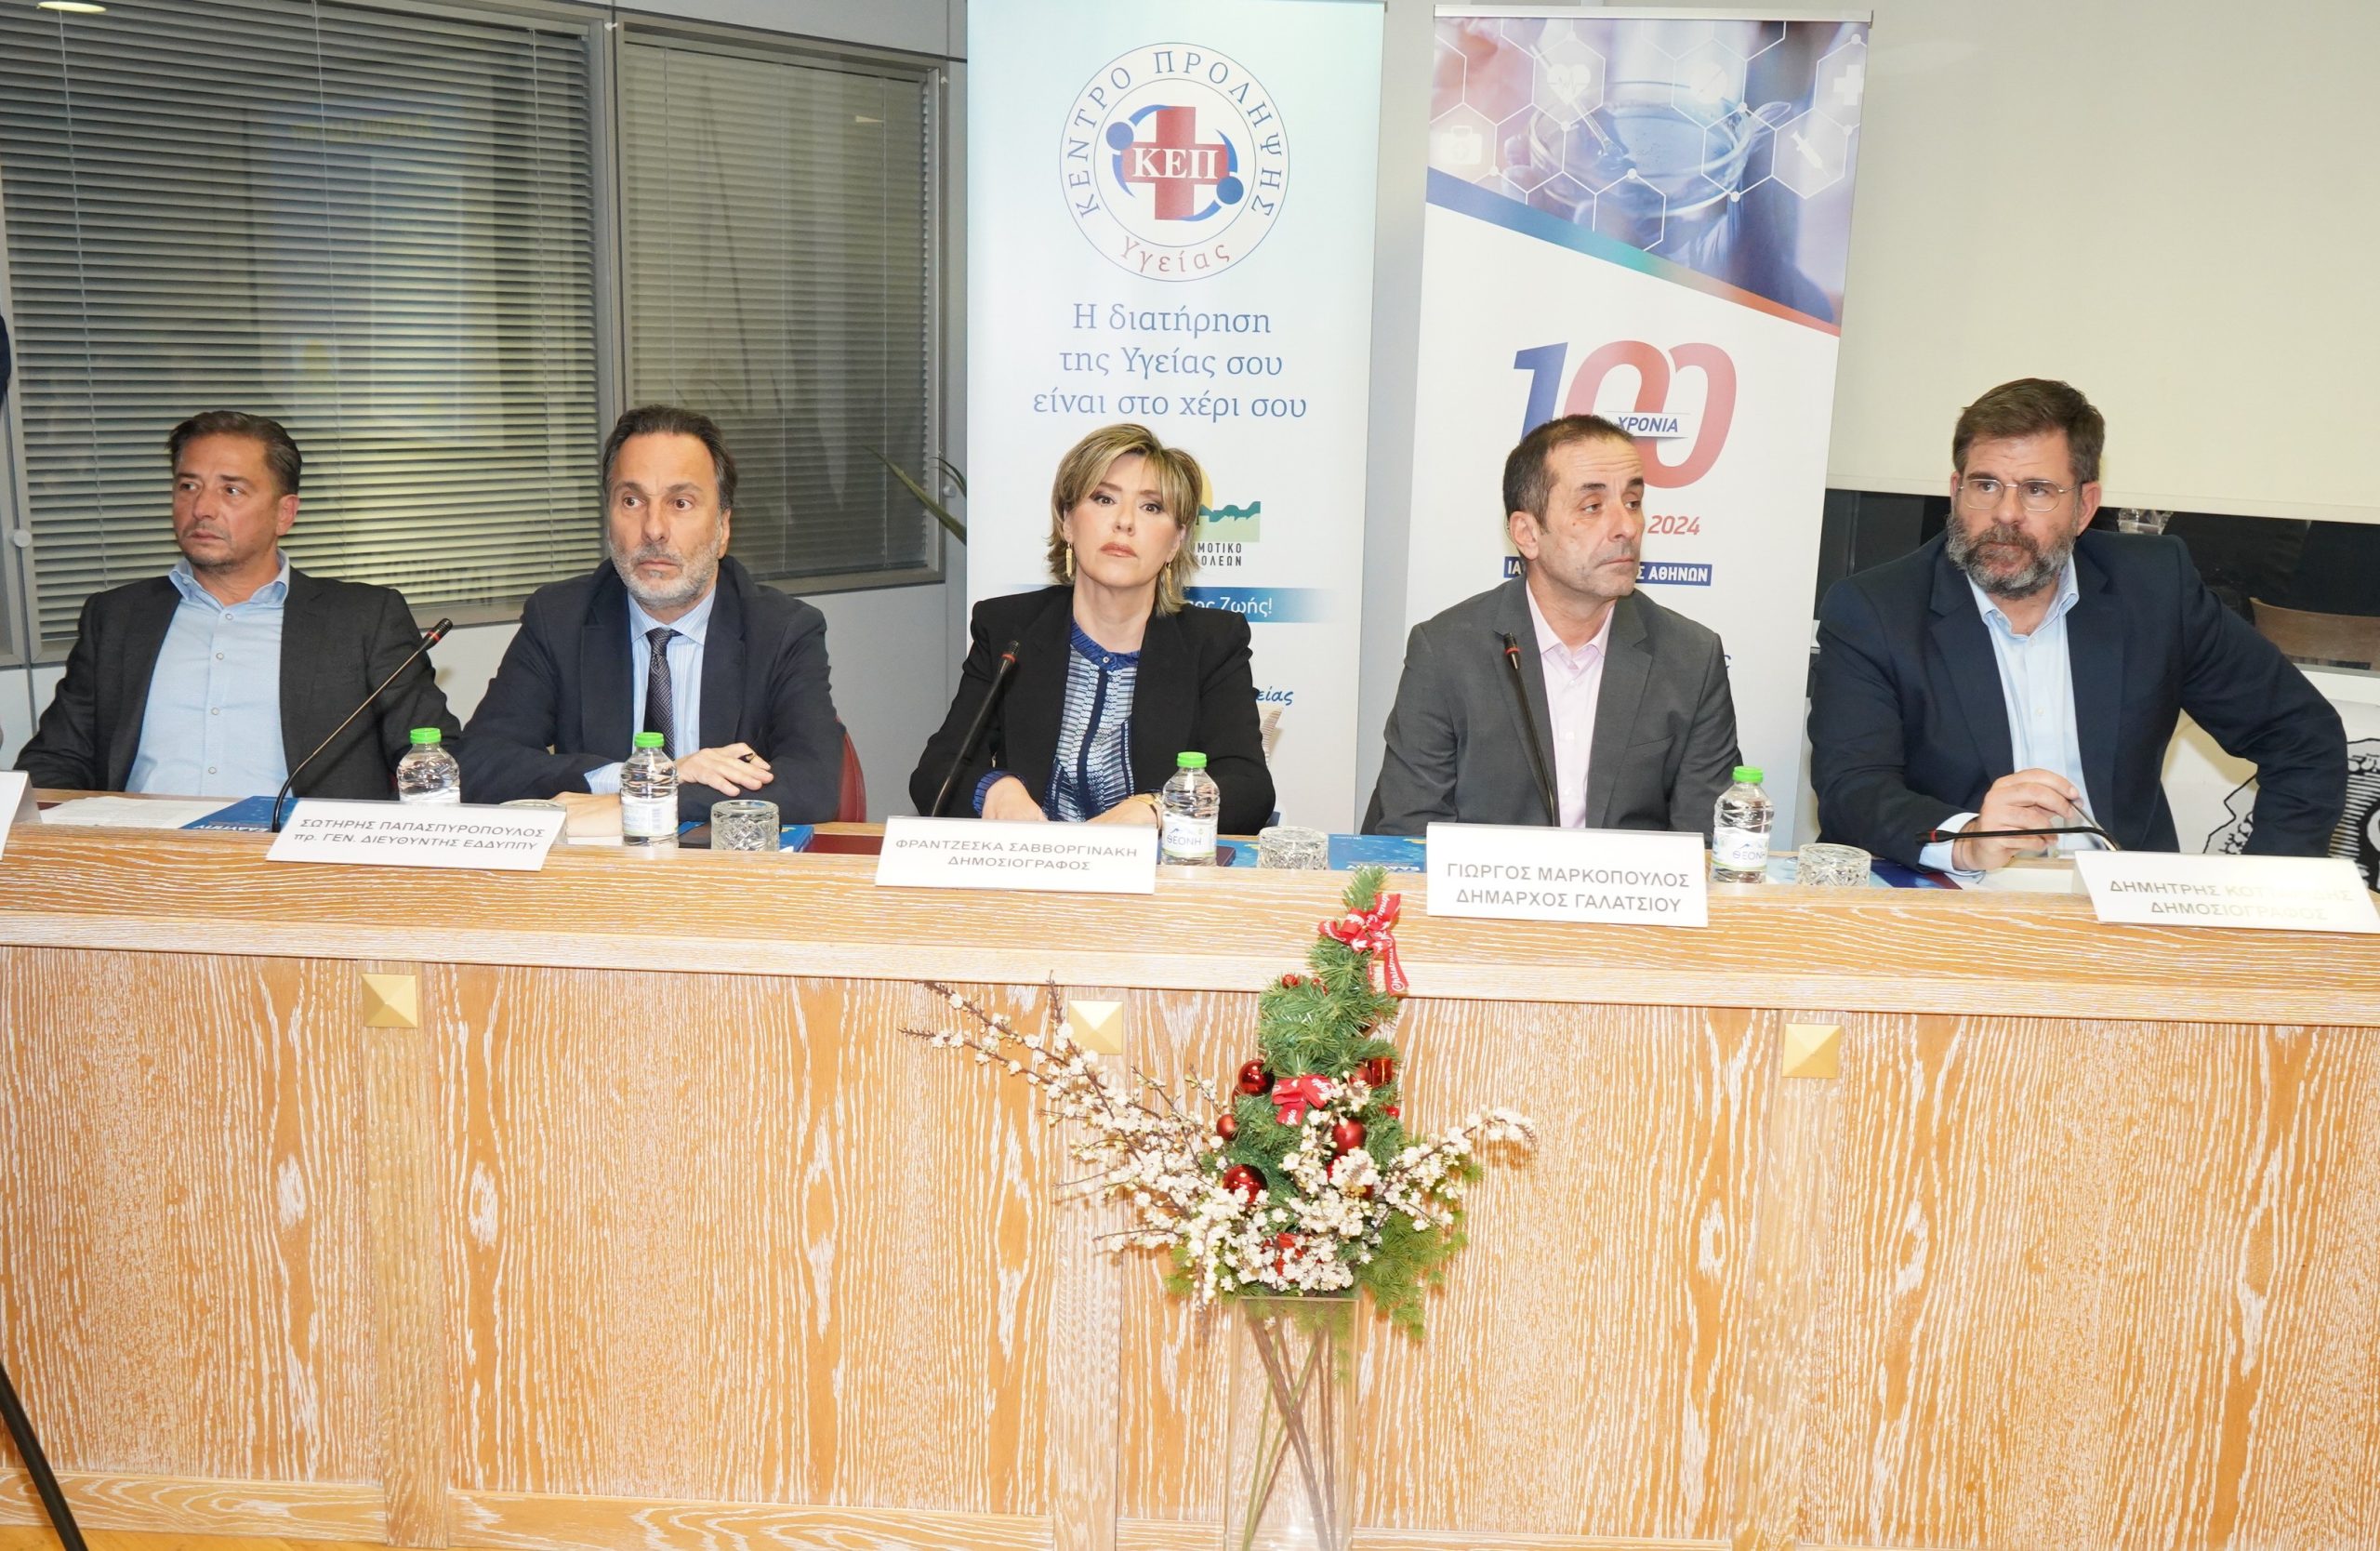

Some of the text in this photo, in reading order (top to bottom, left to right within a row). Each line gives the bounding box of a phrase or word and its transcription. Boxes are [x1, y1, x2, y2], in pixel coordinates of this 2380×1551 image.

[1067, 50, 1283, 218] ΚΕΝΤΡΟ ΠΡΟΛΗΨΗΣ
[1131, 146, 1219, 180] ΚΕΠ
[1121, 235, 1230, 273] Υγείας
[1073, 303, 1271, 338] Η διατήρηση
[1060, 347, 1283, 379] της Υγείας σου
[1033, 388, 1307, 423] είναι στο χέρι σου
[1618, 417, 1678, 432] ΧΡΟΝΙΑ
[1646, 514, 1700, 536] 2024
[1194, 542, 1242, 553] ΜΟΤΙΚΟ
[1197, 555, 1242, 566] ΟΛΕΩΝ
[1647, 565, 1708, 582] ΑΘΗΝΩΝ
[1256, 685, 1294, 707] είας
[299, 818, 546, 838] ΣΩΤΗΡΗΣ ΠΑΠΑΣΠΥΡΟΠΟΥΛΟΣ
[322, 833, 356, 843] ΓΕΝ.
[361, 834, 459, 848] ΔΙΕΥΘΥΝΤΗΣ
[463, 840, 538, 851] ΕΔΔΥΠΠΥ
[895, 839, 1138, 857] ΦΡΑΝΤΖΕΣΚΑ ΣΑΒΒΟΡΓΙΝΑΚΗ
[947, 855, 1091, 870] ΔΗΜΟΣΙΟΓΡΑΦΟΣ
[1447, 863, 1690, 888] ΓΙΩΡΓΟΣ ΜΑΡΚΟΠΟΥΛΟΣ
[2109, 881, 2221, 896] ΔΗΜΗΤΡΗΣ
[1456, 889, 1682, 912] ΔΗΜΑΡΧΟΣ ΓΑΛΑΤΣΙΟΥ
